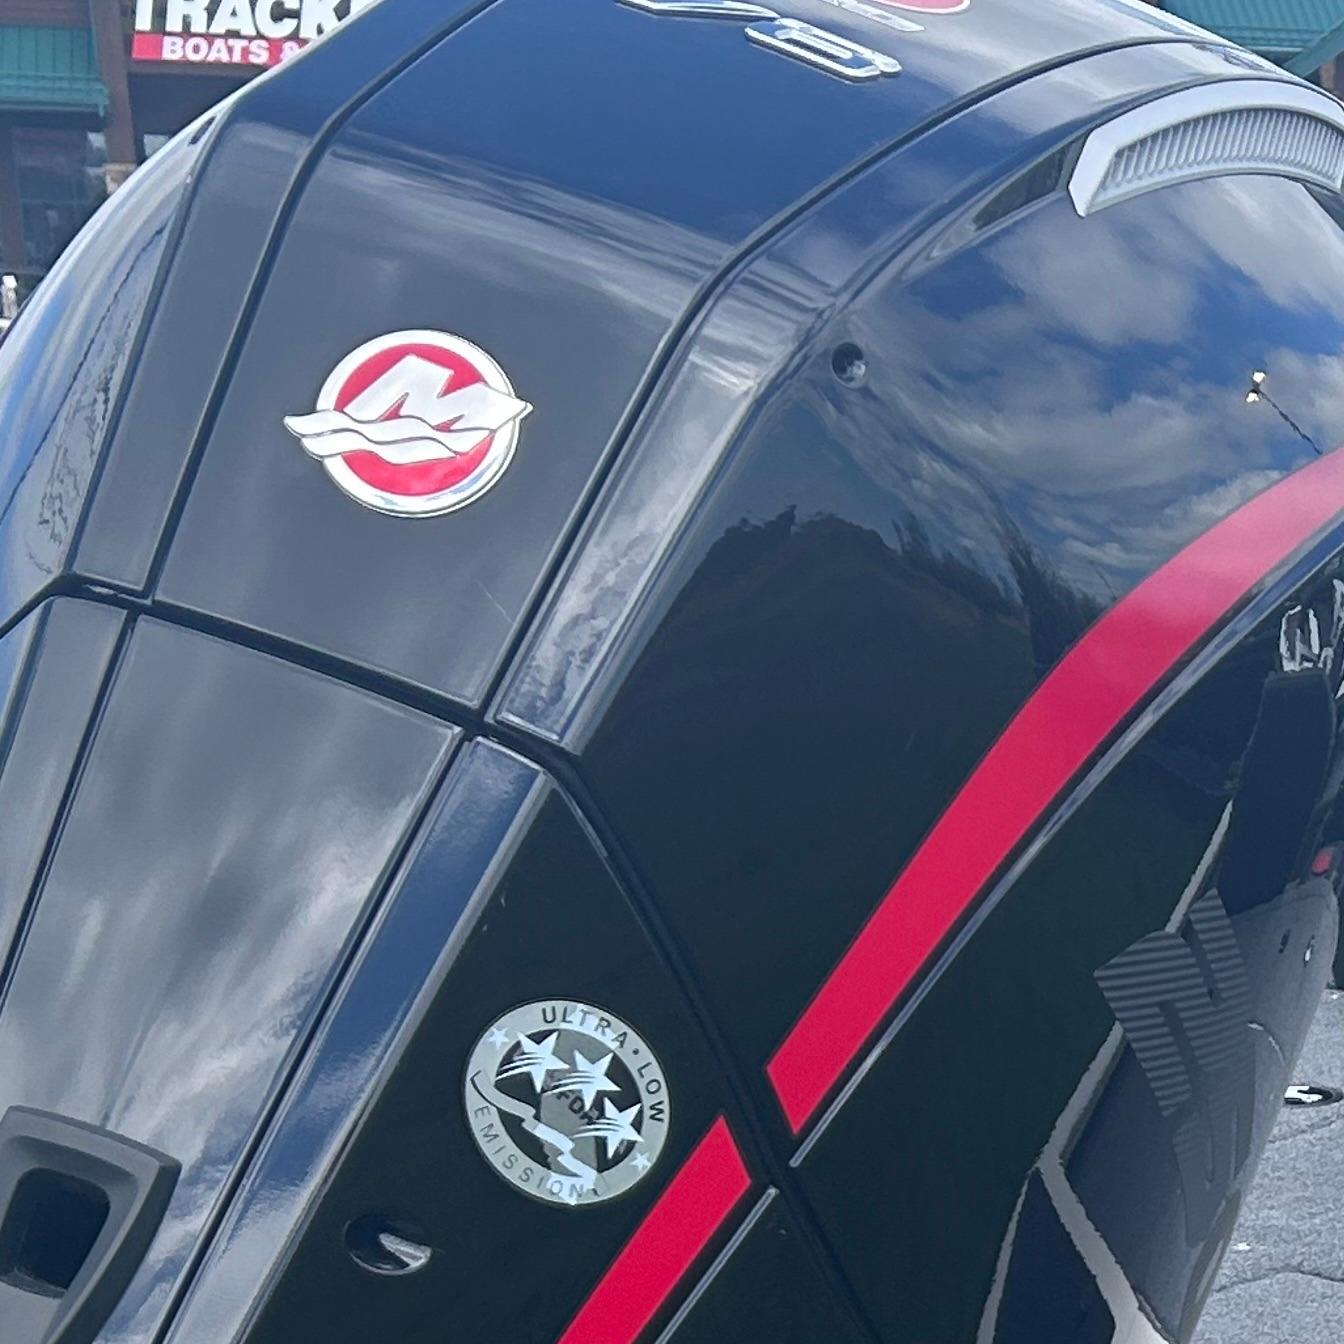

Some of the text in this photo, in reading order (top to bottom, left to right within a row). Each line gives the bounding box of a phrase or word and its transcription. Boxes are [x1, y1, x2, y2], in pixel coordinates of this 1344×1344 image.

[135, 0, 378, 39] TRACK
[161, 35, 270, 66] BOATS
[541, 1006, 629, 1050] ULTRA
[635, 1061, 667, 1124] LOW
